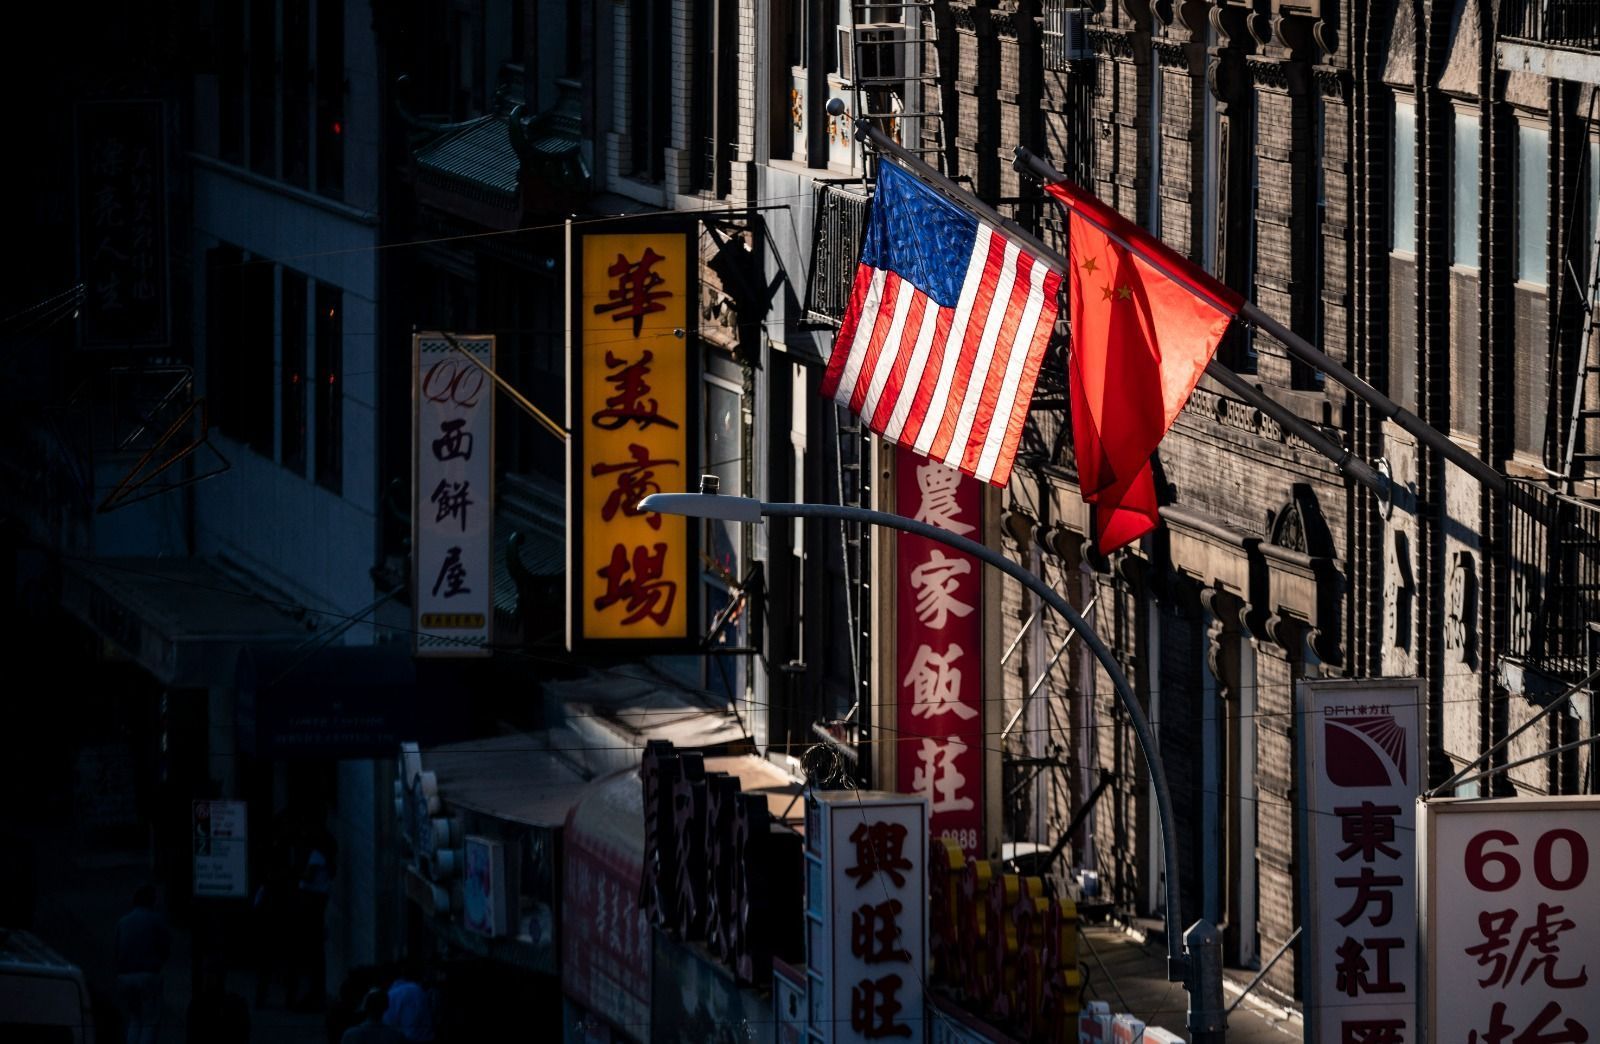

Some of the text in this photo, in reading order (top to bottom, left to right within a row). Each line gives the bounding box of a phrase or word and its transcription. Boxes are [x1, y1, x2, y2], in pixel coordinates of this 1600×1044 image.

[422, 358, 484, 408] QQ
[593, 247, 679, 626] 華美商場
[431, 418, 473, 598] 西餅屋
[845, 821, 913, 1037] 興旺旺
[1464, 829, 1589, 892] 60
